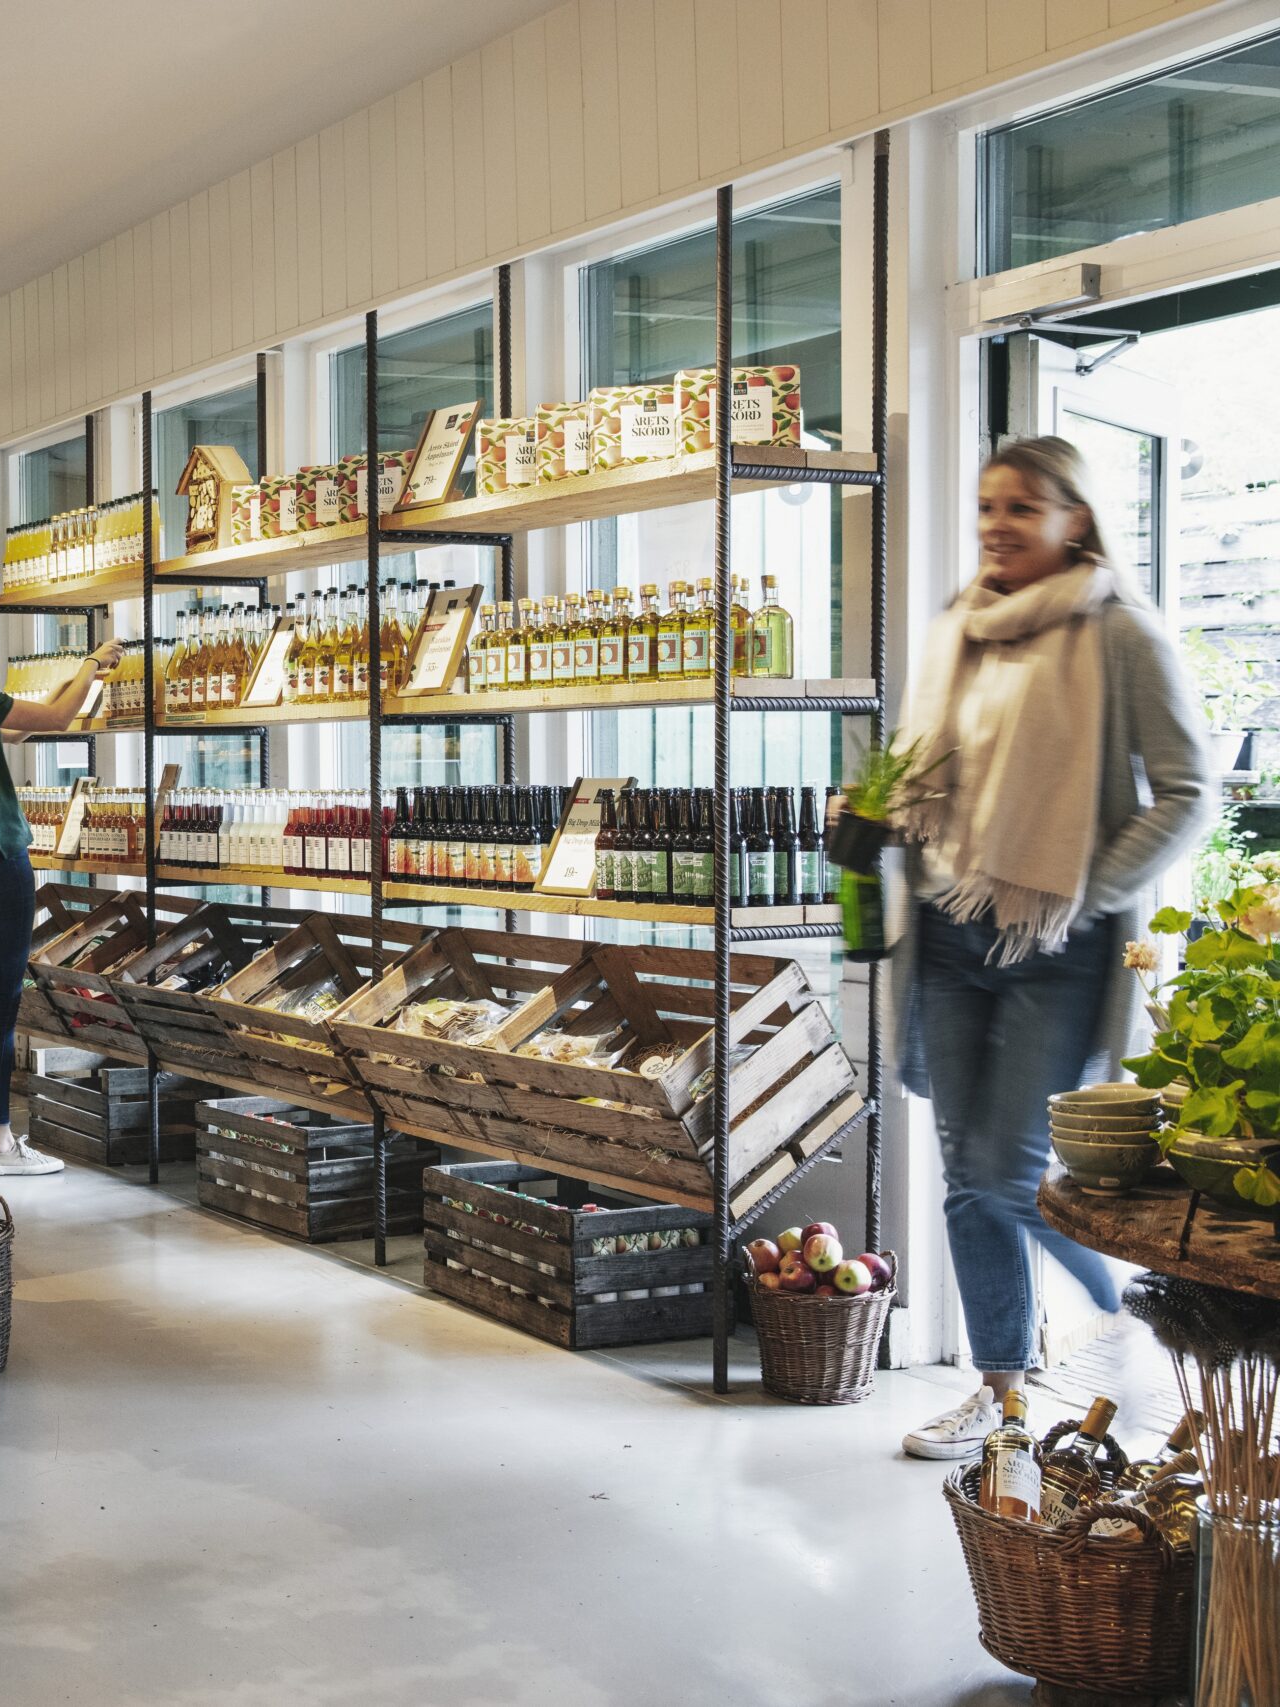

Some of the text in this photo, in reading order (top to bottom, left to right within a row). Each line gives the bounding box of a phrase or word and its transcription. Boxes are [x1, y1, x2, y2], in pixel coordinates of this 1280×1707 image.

[632, 414, 669, 426] ÅRETS
[632, 425, 670, 437] SKÖRD
[517, 444, 536, 455] ÅRE
[516, 454, 536, 465] SKÖ
